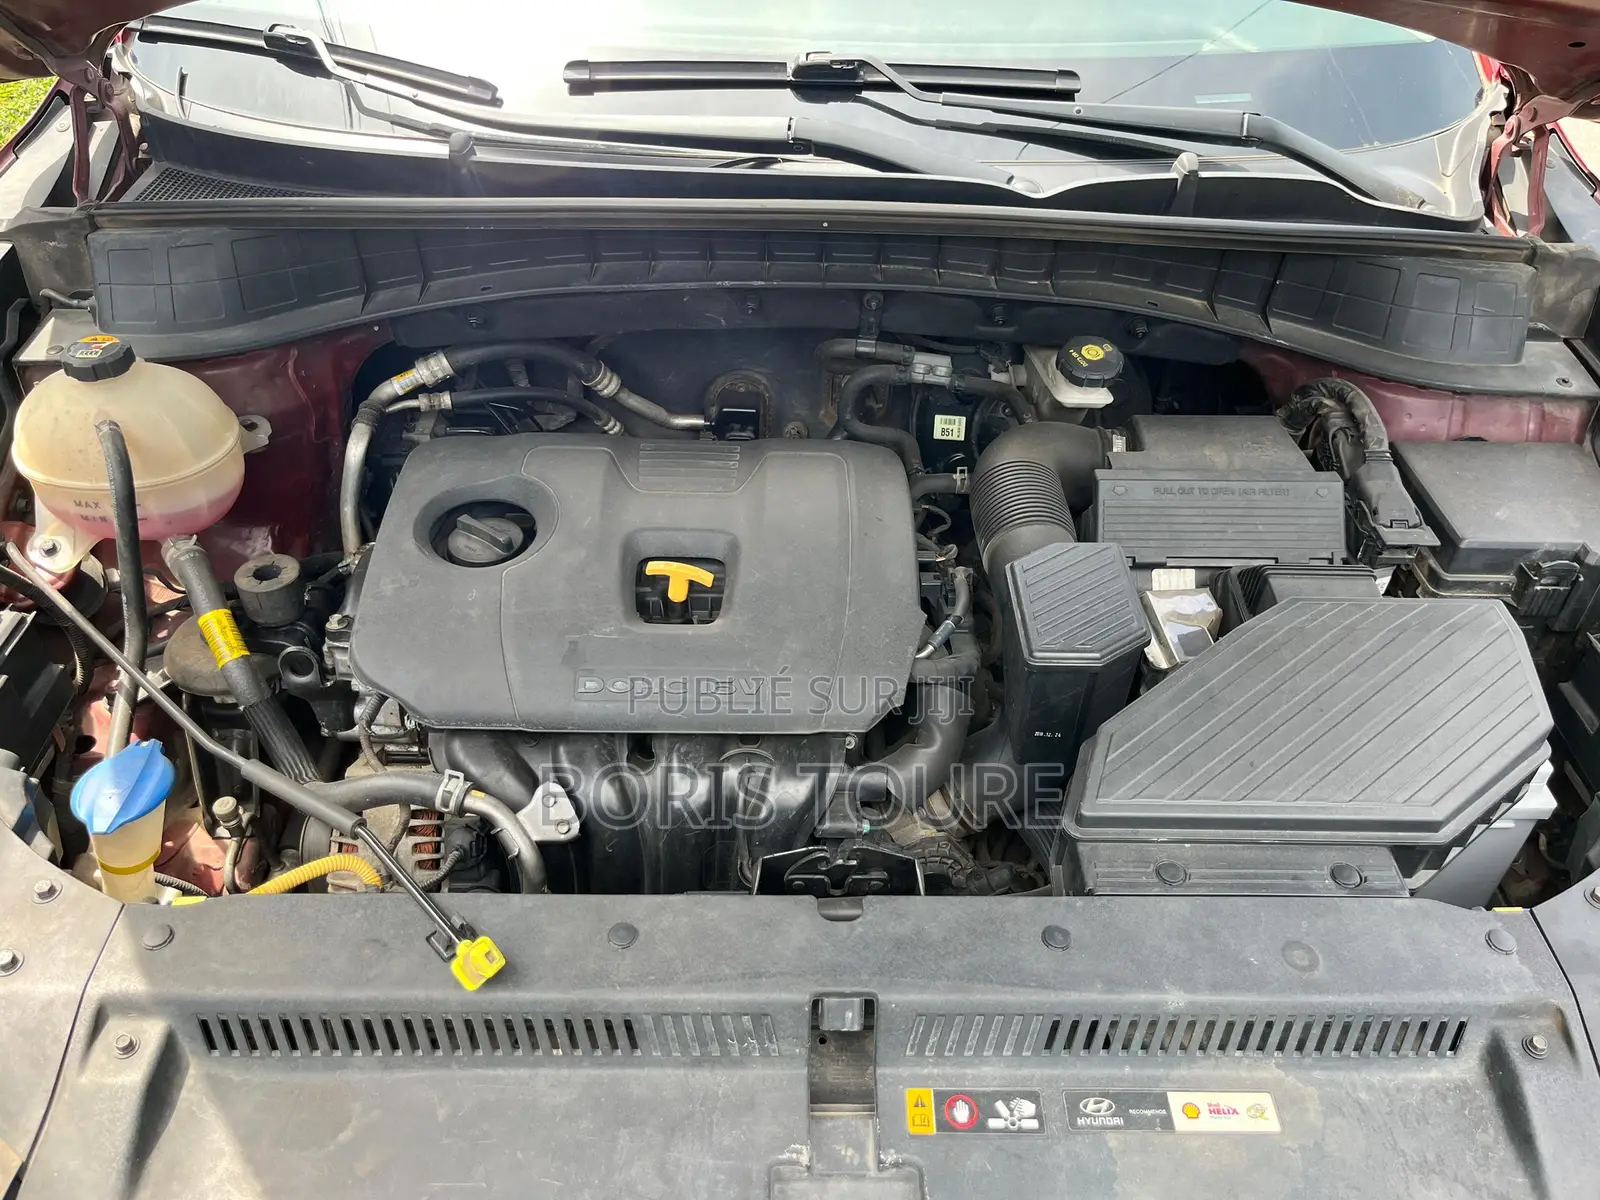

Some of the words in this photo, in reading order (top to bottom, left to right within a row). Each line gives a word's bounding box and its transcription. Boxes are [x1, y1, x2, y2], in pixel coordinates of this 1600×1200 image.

[941, 427, 954, 437] B51
[1153, 487, 1176, 495] PULL
[1177, 487, 1195, 495] OUT
[1198, 487, 1209, 495] TO
[73, 500, 101, 509] MAX
[1208, 1108, 1240, 1116] HELIX
[1076, 1116, 1124, 1126] HYUNDAI
